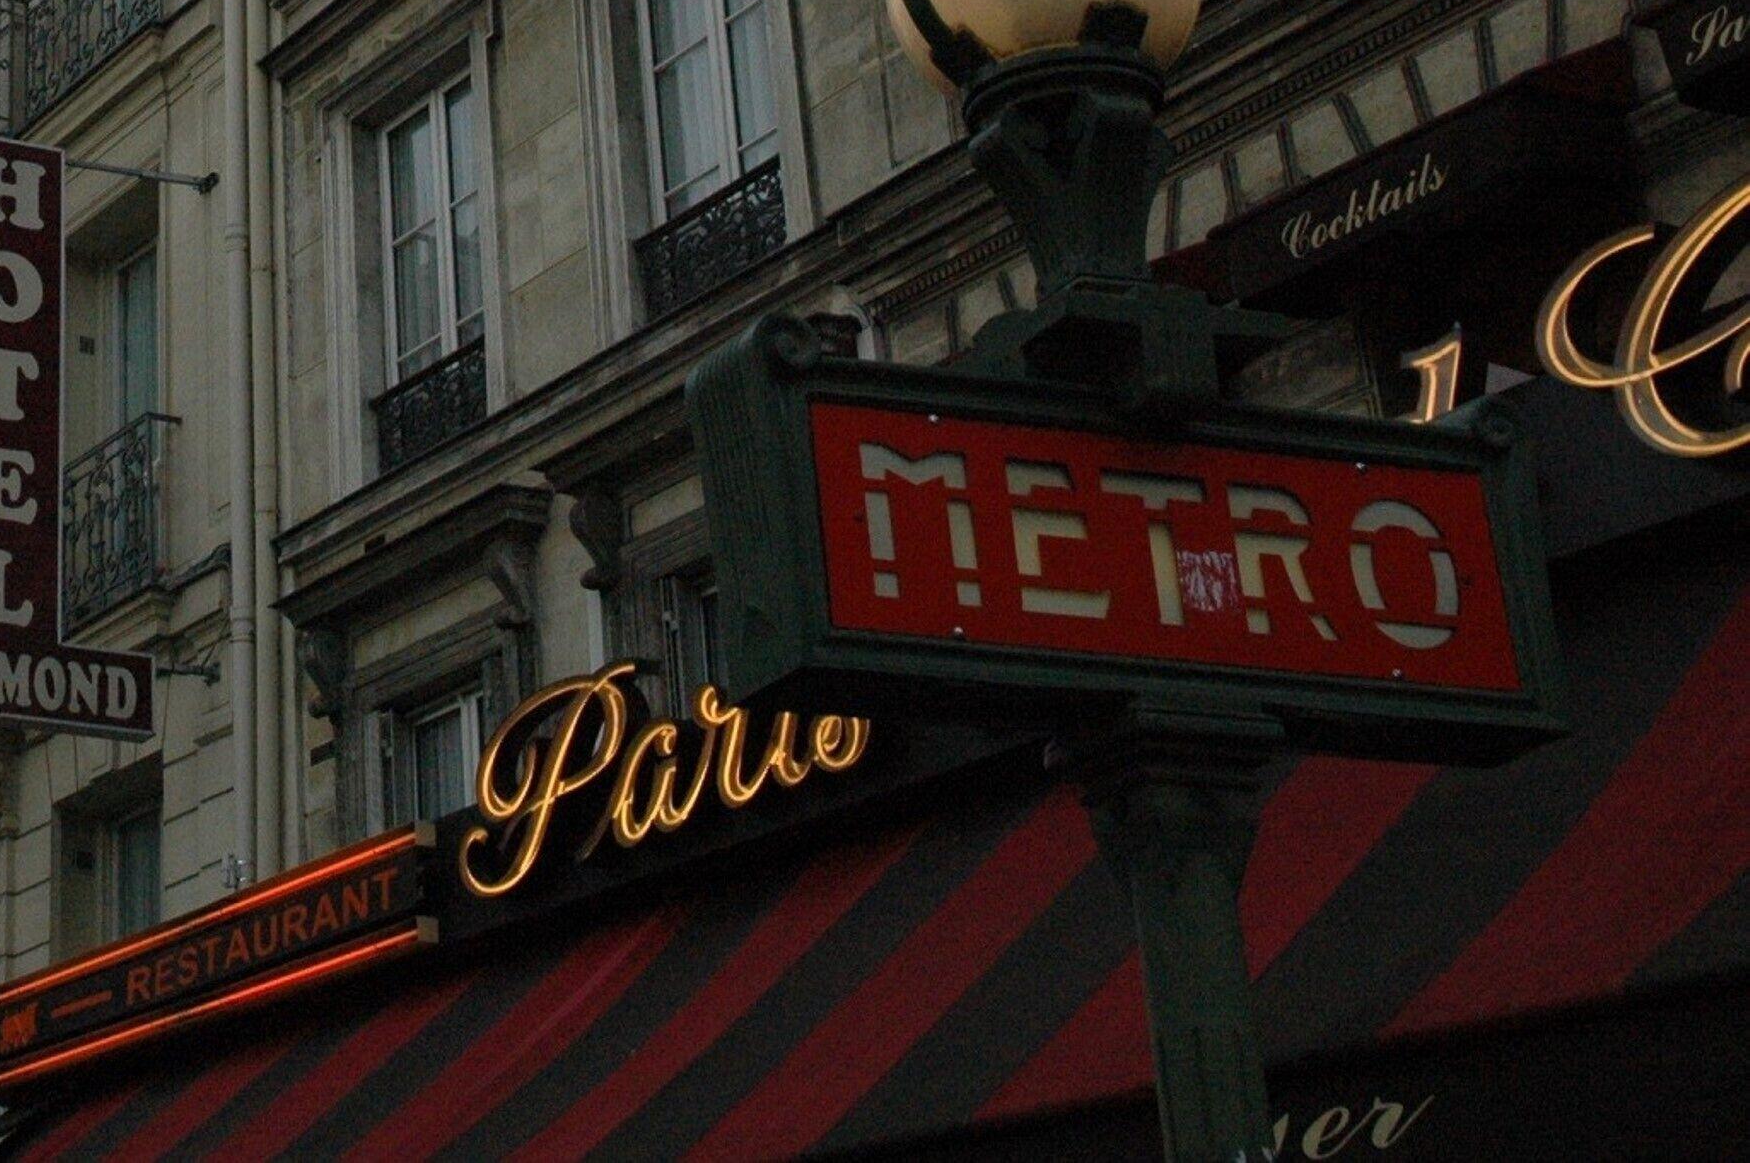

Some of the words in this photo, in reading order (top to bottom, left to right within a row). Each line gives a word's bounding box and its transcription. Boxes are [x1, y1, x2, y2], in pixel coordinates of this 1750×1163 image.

[1279, 151, 1447, 260] Cocktails
[857, 441, 1462, 651] METRO
[124, 866, 400, 1006] RESTAURANT
